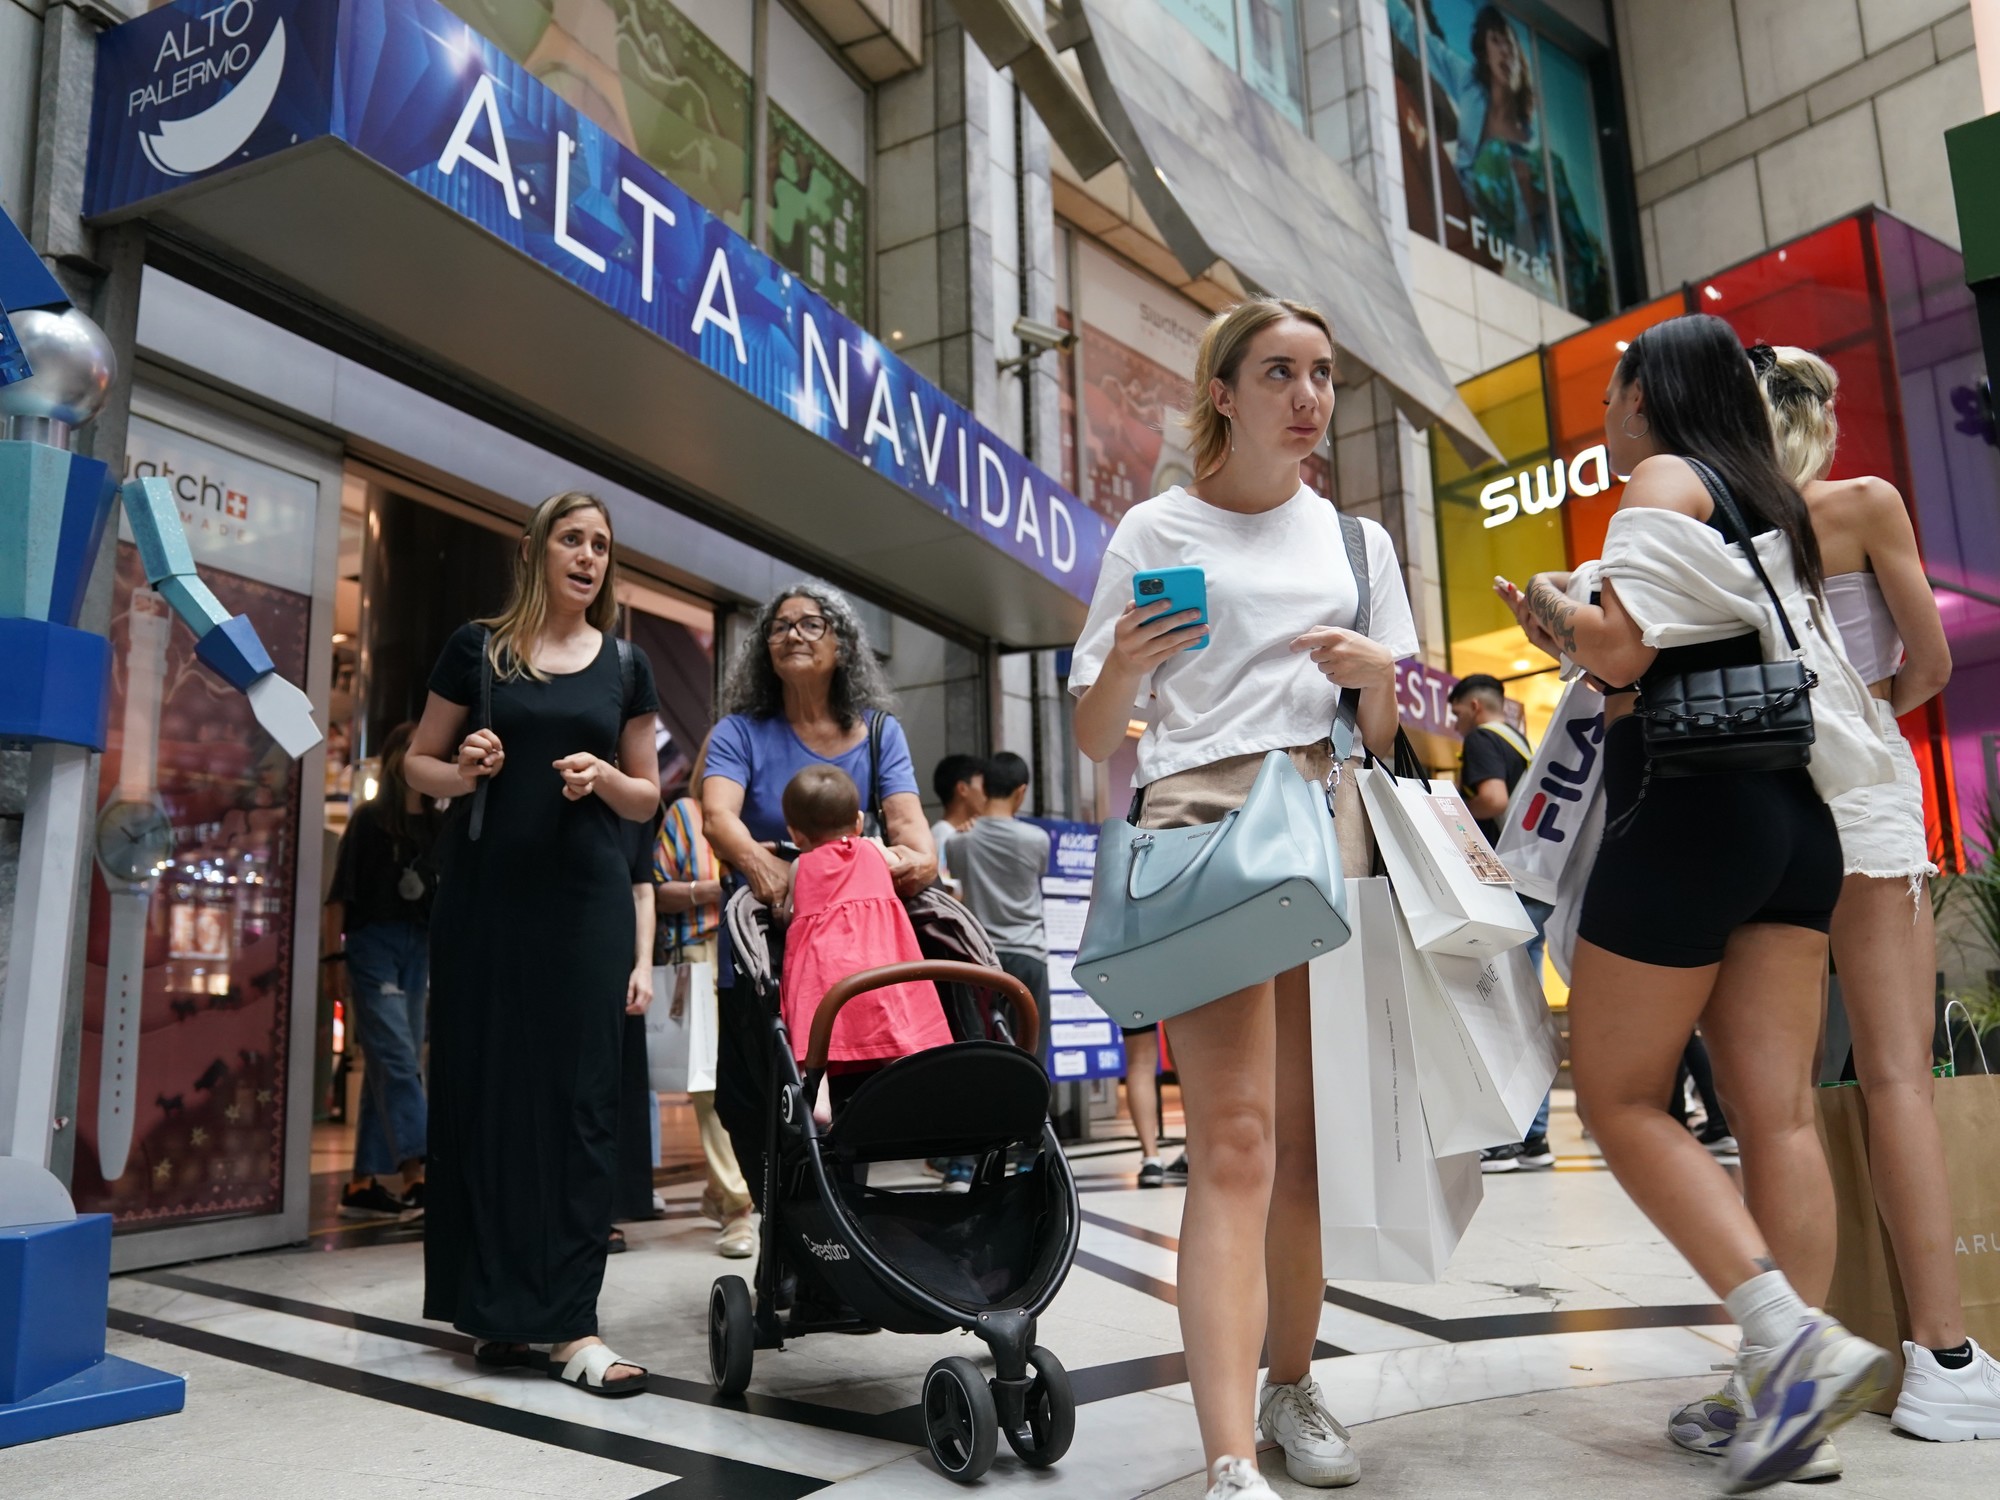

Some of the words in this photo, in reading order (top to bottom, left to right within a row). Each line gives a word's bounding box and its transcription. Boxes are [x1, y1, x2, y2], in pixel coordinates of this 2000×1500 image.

[154, 0, 253, 73] ALTO
[128, 43, 250, 117] PALERMO
[437, 73, 747, 365] ALTA
[803, 312, 1077, 573] NAVIDAD
[1480, 444, 1631, 529] swa
[1522, 712, 1605, 842] FILA
